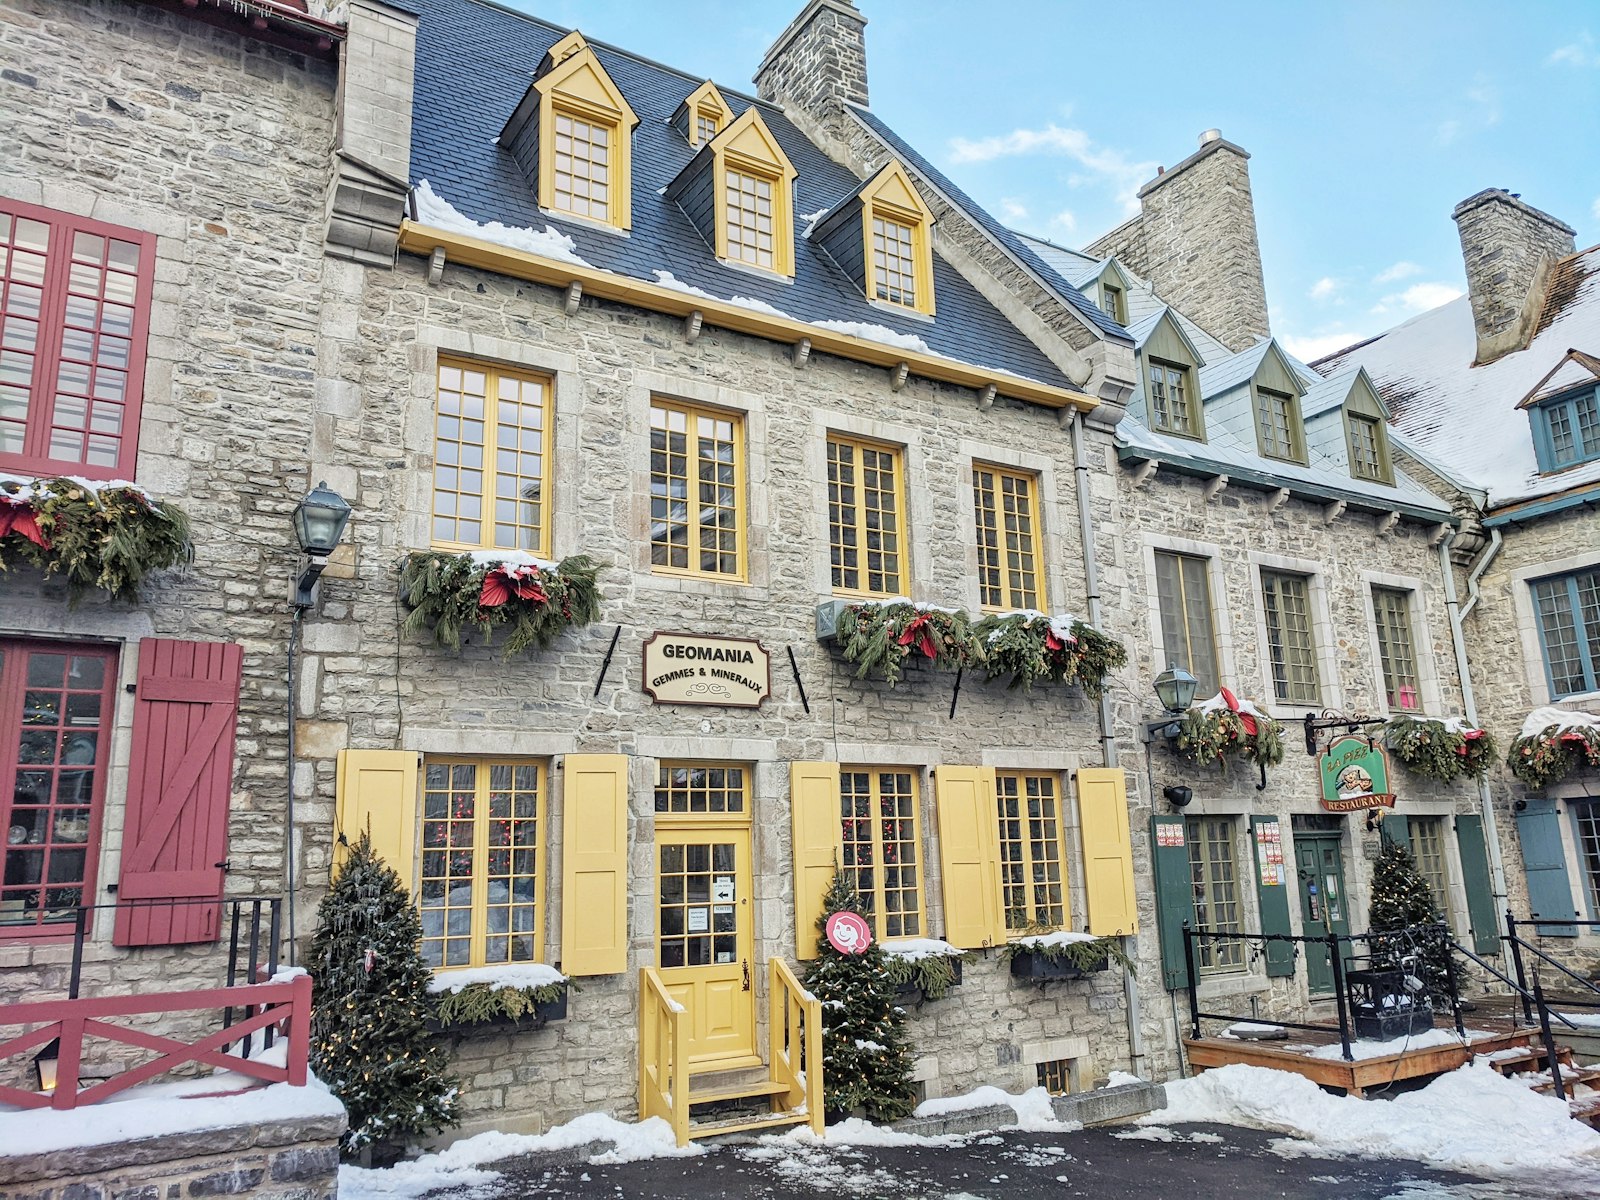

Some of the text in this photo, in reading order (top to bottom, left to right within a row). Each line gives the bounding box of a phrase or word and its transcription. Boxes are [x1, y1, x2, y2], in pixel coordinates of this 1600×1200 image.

[663, 644, 753, 664] GEOMANIA
[652, 667, 762, 693] GEMMES & MINERAUX
[1328, 794, 1388, 811] RESTAURANT
